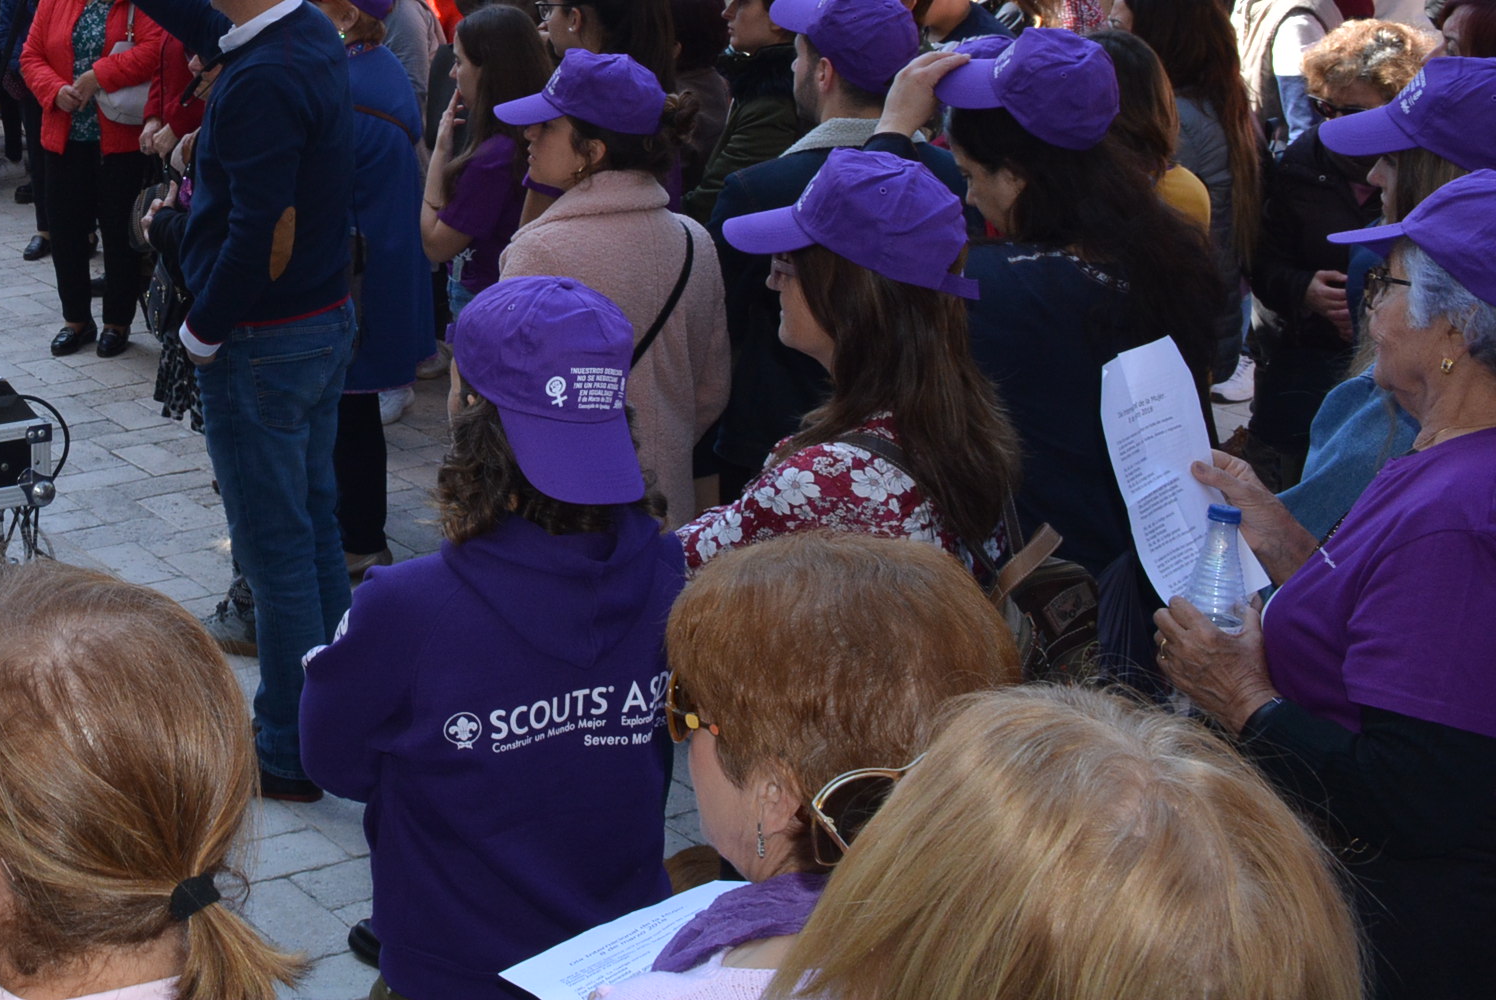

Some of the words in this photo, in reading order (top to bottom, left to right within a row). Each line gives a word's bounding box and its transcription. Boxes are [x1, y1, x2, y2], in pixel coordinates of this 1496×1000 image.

[490, 686, 608, 740] SCOUTS
[492, 734, 533, 753] Construir
[534, 733, 545, 742] un
[547, 721, 576, 738] Mundo
[577, 717, 607, 730] Mejor
[584, 734, 629, 746] Severo
